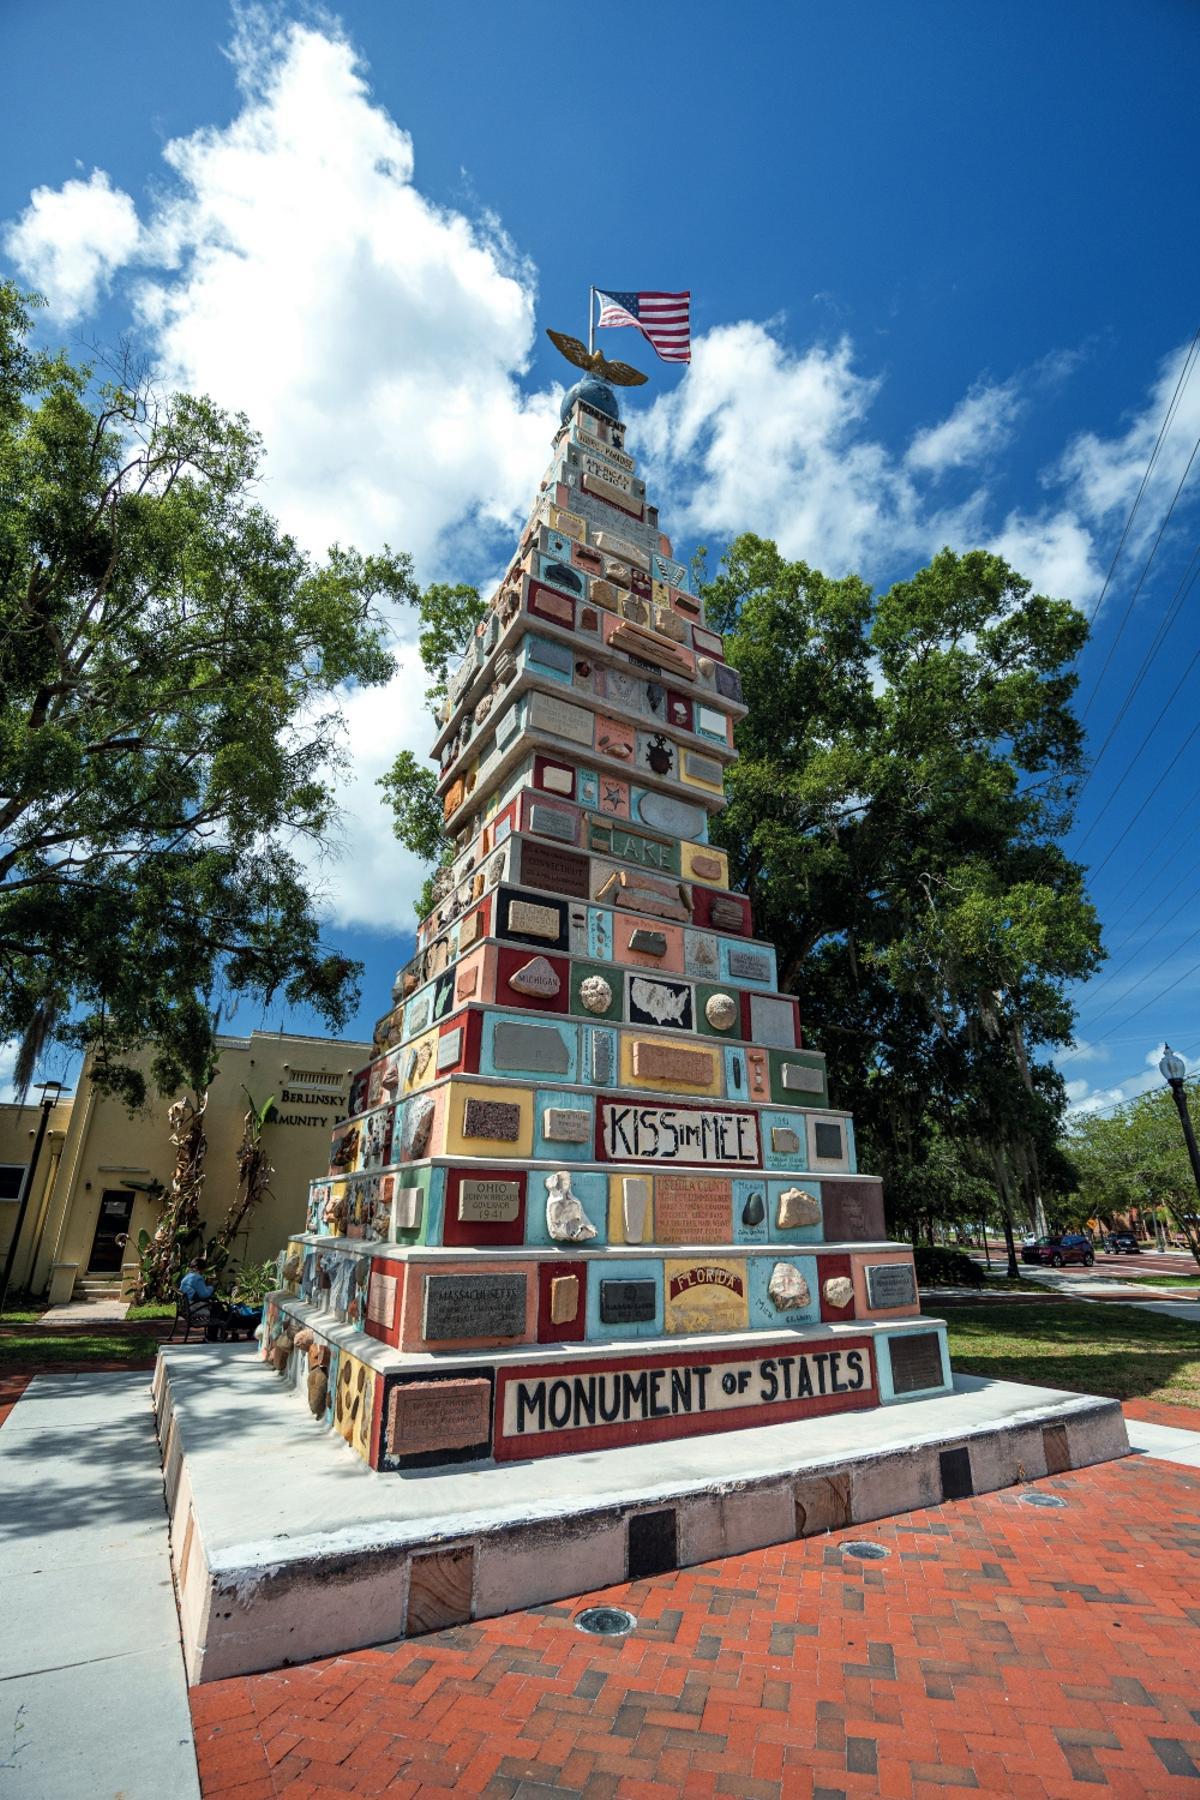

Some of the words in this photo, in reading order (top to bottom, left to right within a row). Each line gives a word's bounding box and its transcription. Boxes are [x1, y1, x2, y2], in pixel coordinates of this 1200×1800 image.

[610, 830, 672, 867] LAKE
[518, 974, 558, 987] MICHIGAN
[281, 1090, 346, 1106] BERLINSKY
[476, 1183, 507, 1194] OHIO
[479, 1210, 503, 1220] 1941
[677, 1267, 735, 1291] FLORIDA
[516, 1367, 712, 1433] MONUMENT
[721, 1370, 752, 1396] OF
[759, 1351, 865, 1402] STATES
